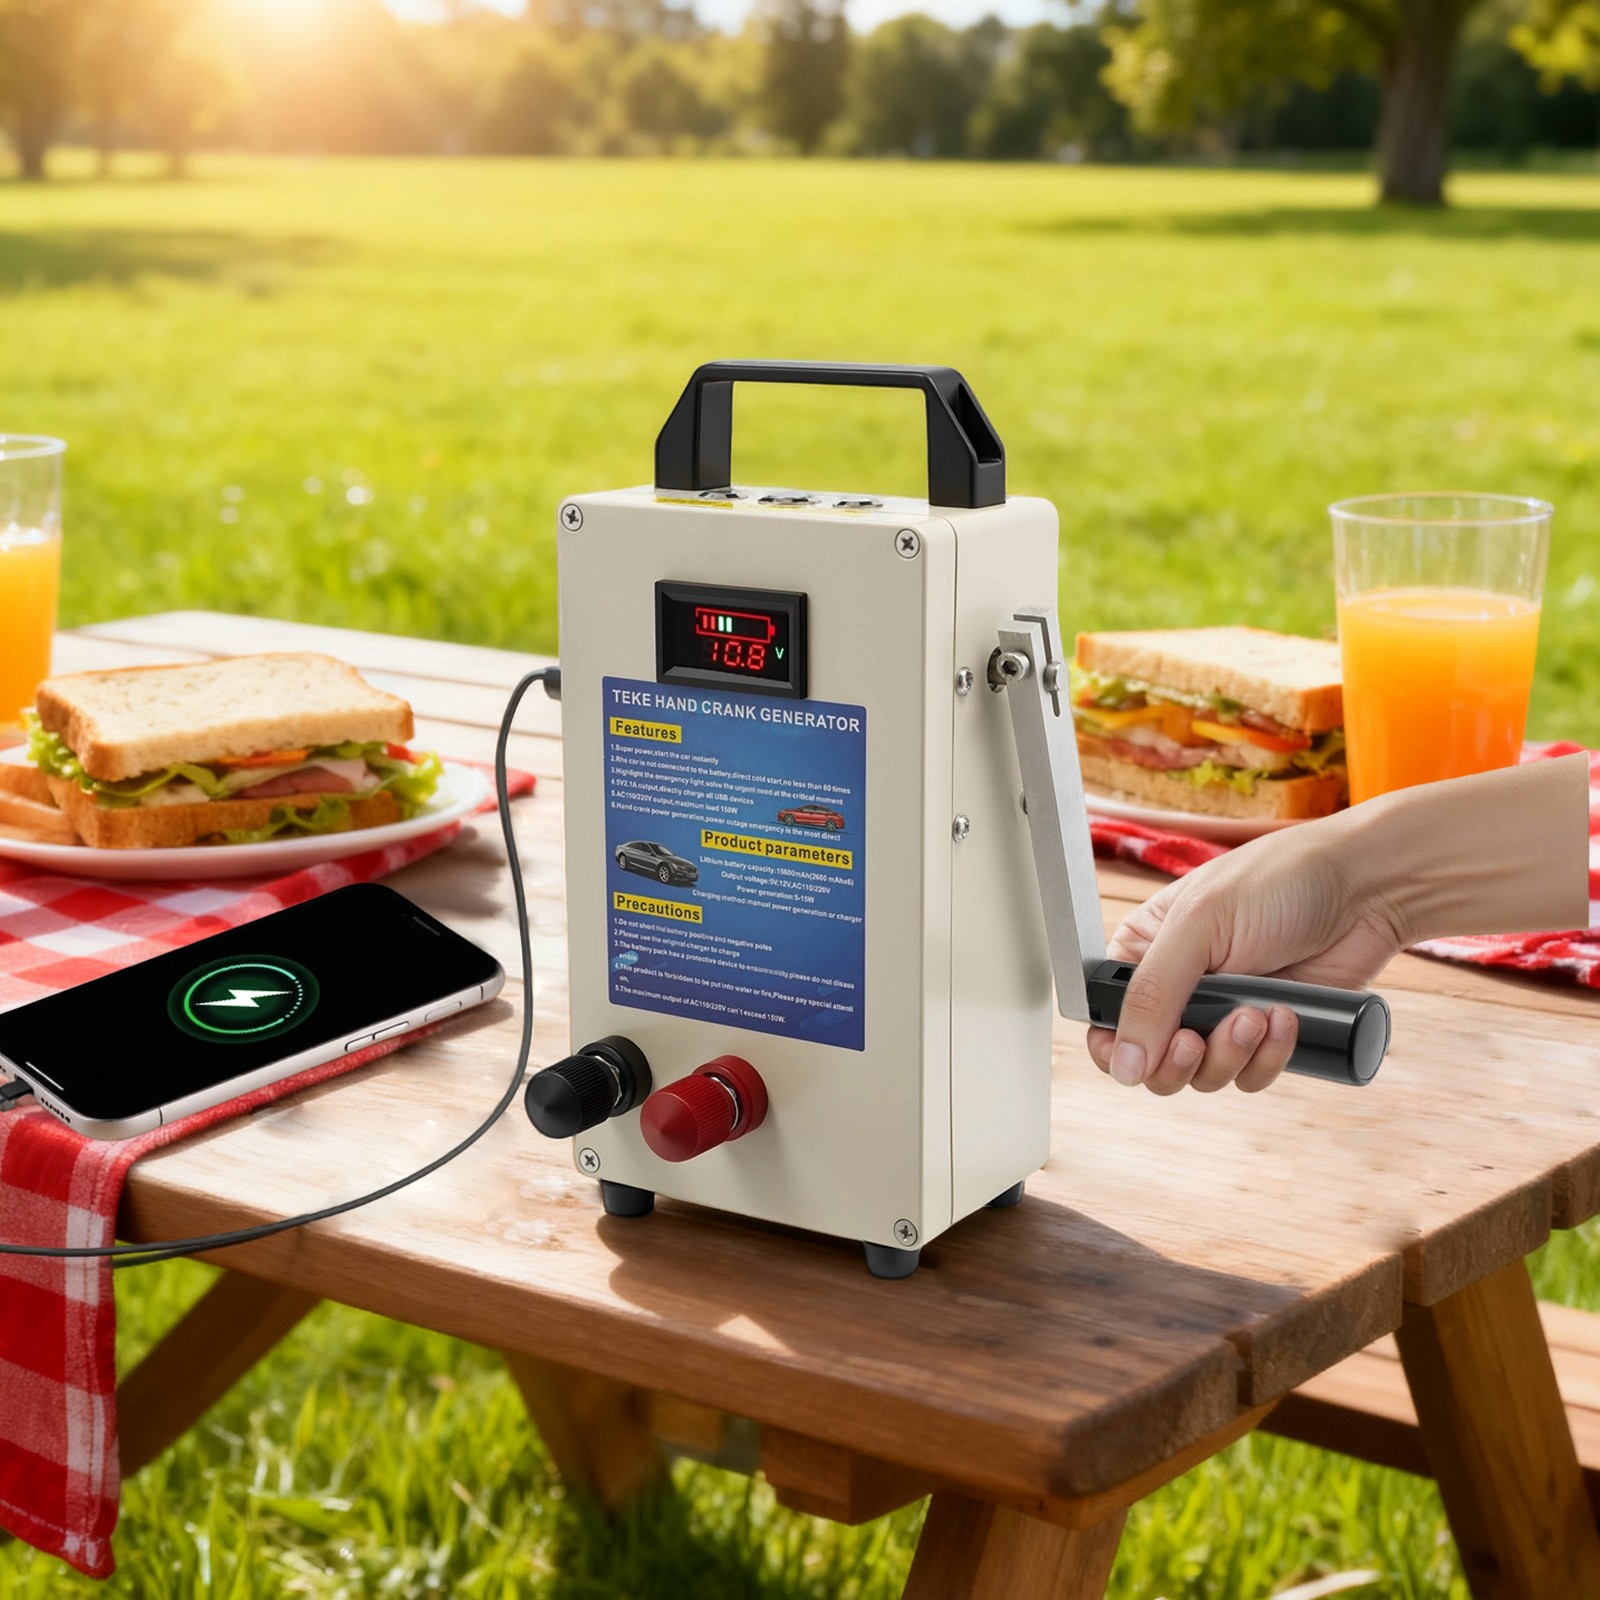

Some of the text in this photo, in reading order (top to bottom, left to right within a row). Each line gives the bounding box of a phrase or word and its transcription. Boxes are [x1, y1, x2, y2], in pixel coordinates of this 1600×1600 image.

[712, 641, 765, 670] 10.8
[612, 689, 860, 733] TEKE HAND CRANK GENERATOR
[616, 720, 676, 740] Features
[669, 751, 679, 759] the
[691, 755, 719, 765] instantly
[655, 773, 689, 785] emergency
[735, 785, 755, 793] urgent
[792, 792, 815, 801] critical
[816, 796, 843, 805] moment
[657, 761, 690, 772] connected
[752, 774, 766, 783] cold
[793, 780, 806, 788] less
[807, 782, 822, 790] than
[832, 785, 851, 794] times
[683, 789, 704, 799] charge
[714, 793, 728, 801] USB
[729, 796, 754, 805] devices
[705, 803, 719, 811] load
[720, 805, 738, 814] 150W
[611, 801, 632, 811] 6.Hand
[633, 804, 651, 813] crank
[651, 808, 670, 818] power
[726, 820, 748, 828] outage
[749, 822, 784, 834] emergency
[792, 827, 803, 835] the
[804, 829, 820, 838] most
[821, 831, 841, 841] direct
[700, 856, 723, 866] Lithium
[724, 859, 747, 870] battery
[705, 831, 850, 865] Product parameters
[721, 871, 743, 881] Output
[737, 885, 757, 894] Power
[617, 895, 700, 920] Precautions
[692, 889, 721, 900] Charging
[772, 902, 791, 912] power
[792, 906, 827, 918] generation
[836, 914, 862, 923] charger
[614, 918, 627, 926] 1.Do
[628, 920, 639, 928] not
[639, 922, 655, 931] short
[689, 931, 713, 941] positive
[713, 935, 726, 943] and
[727, 937, 754, 948] negative
[755, 943, 773, 952] poles
[614, 929, 639, 939] 2.Please
[651, 935, 661, 943] the
[662, 938, 686, 948] original
[686, 941, 710, 951] charger
[718, 947, 740, 958] charge
[614, 940, 630, 949] 3.The
[631, 943, 653, 954] battery
[653, 946, 668, 956] pack
[668, 950, 680, 958] has
[686, 953, 716, 964] protective
[717, 957, 738, 968] device
[833, 979, 855, 989] disass
[614, 963, 632, 972] 4.This
[633, 966, 657, 977] product
[657, 970, 664, 978] is
[664, 971, 693, 984] forbidden
[710, 981, 721, 989] put
[722, 983, 734, 991] into
[735, 986, 753, 994] water
[795, 997, 808, 1005] pay
[808, 999, 832, 1009] special
[833, 1003, 854, 1012] attenti
[615, 984, 632, 994] 5.The
[632, 988, 661, 1000] maximum
[662, 994, 682, 1003] output
[690, 999, 726, 1012] AC110/220V
[744, 1010, 766, 1020] exceed
